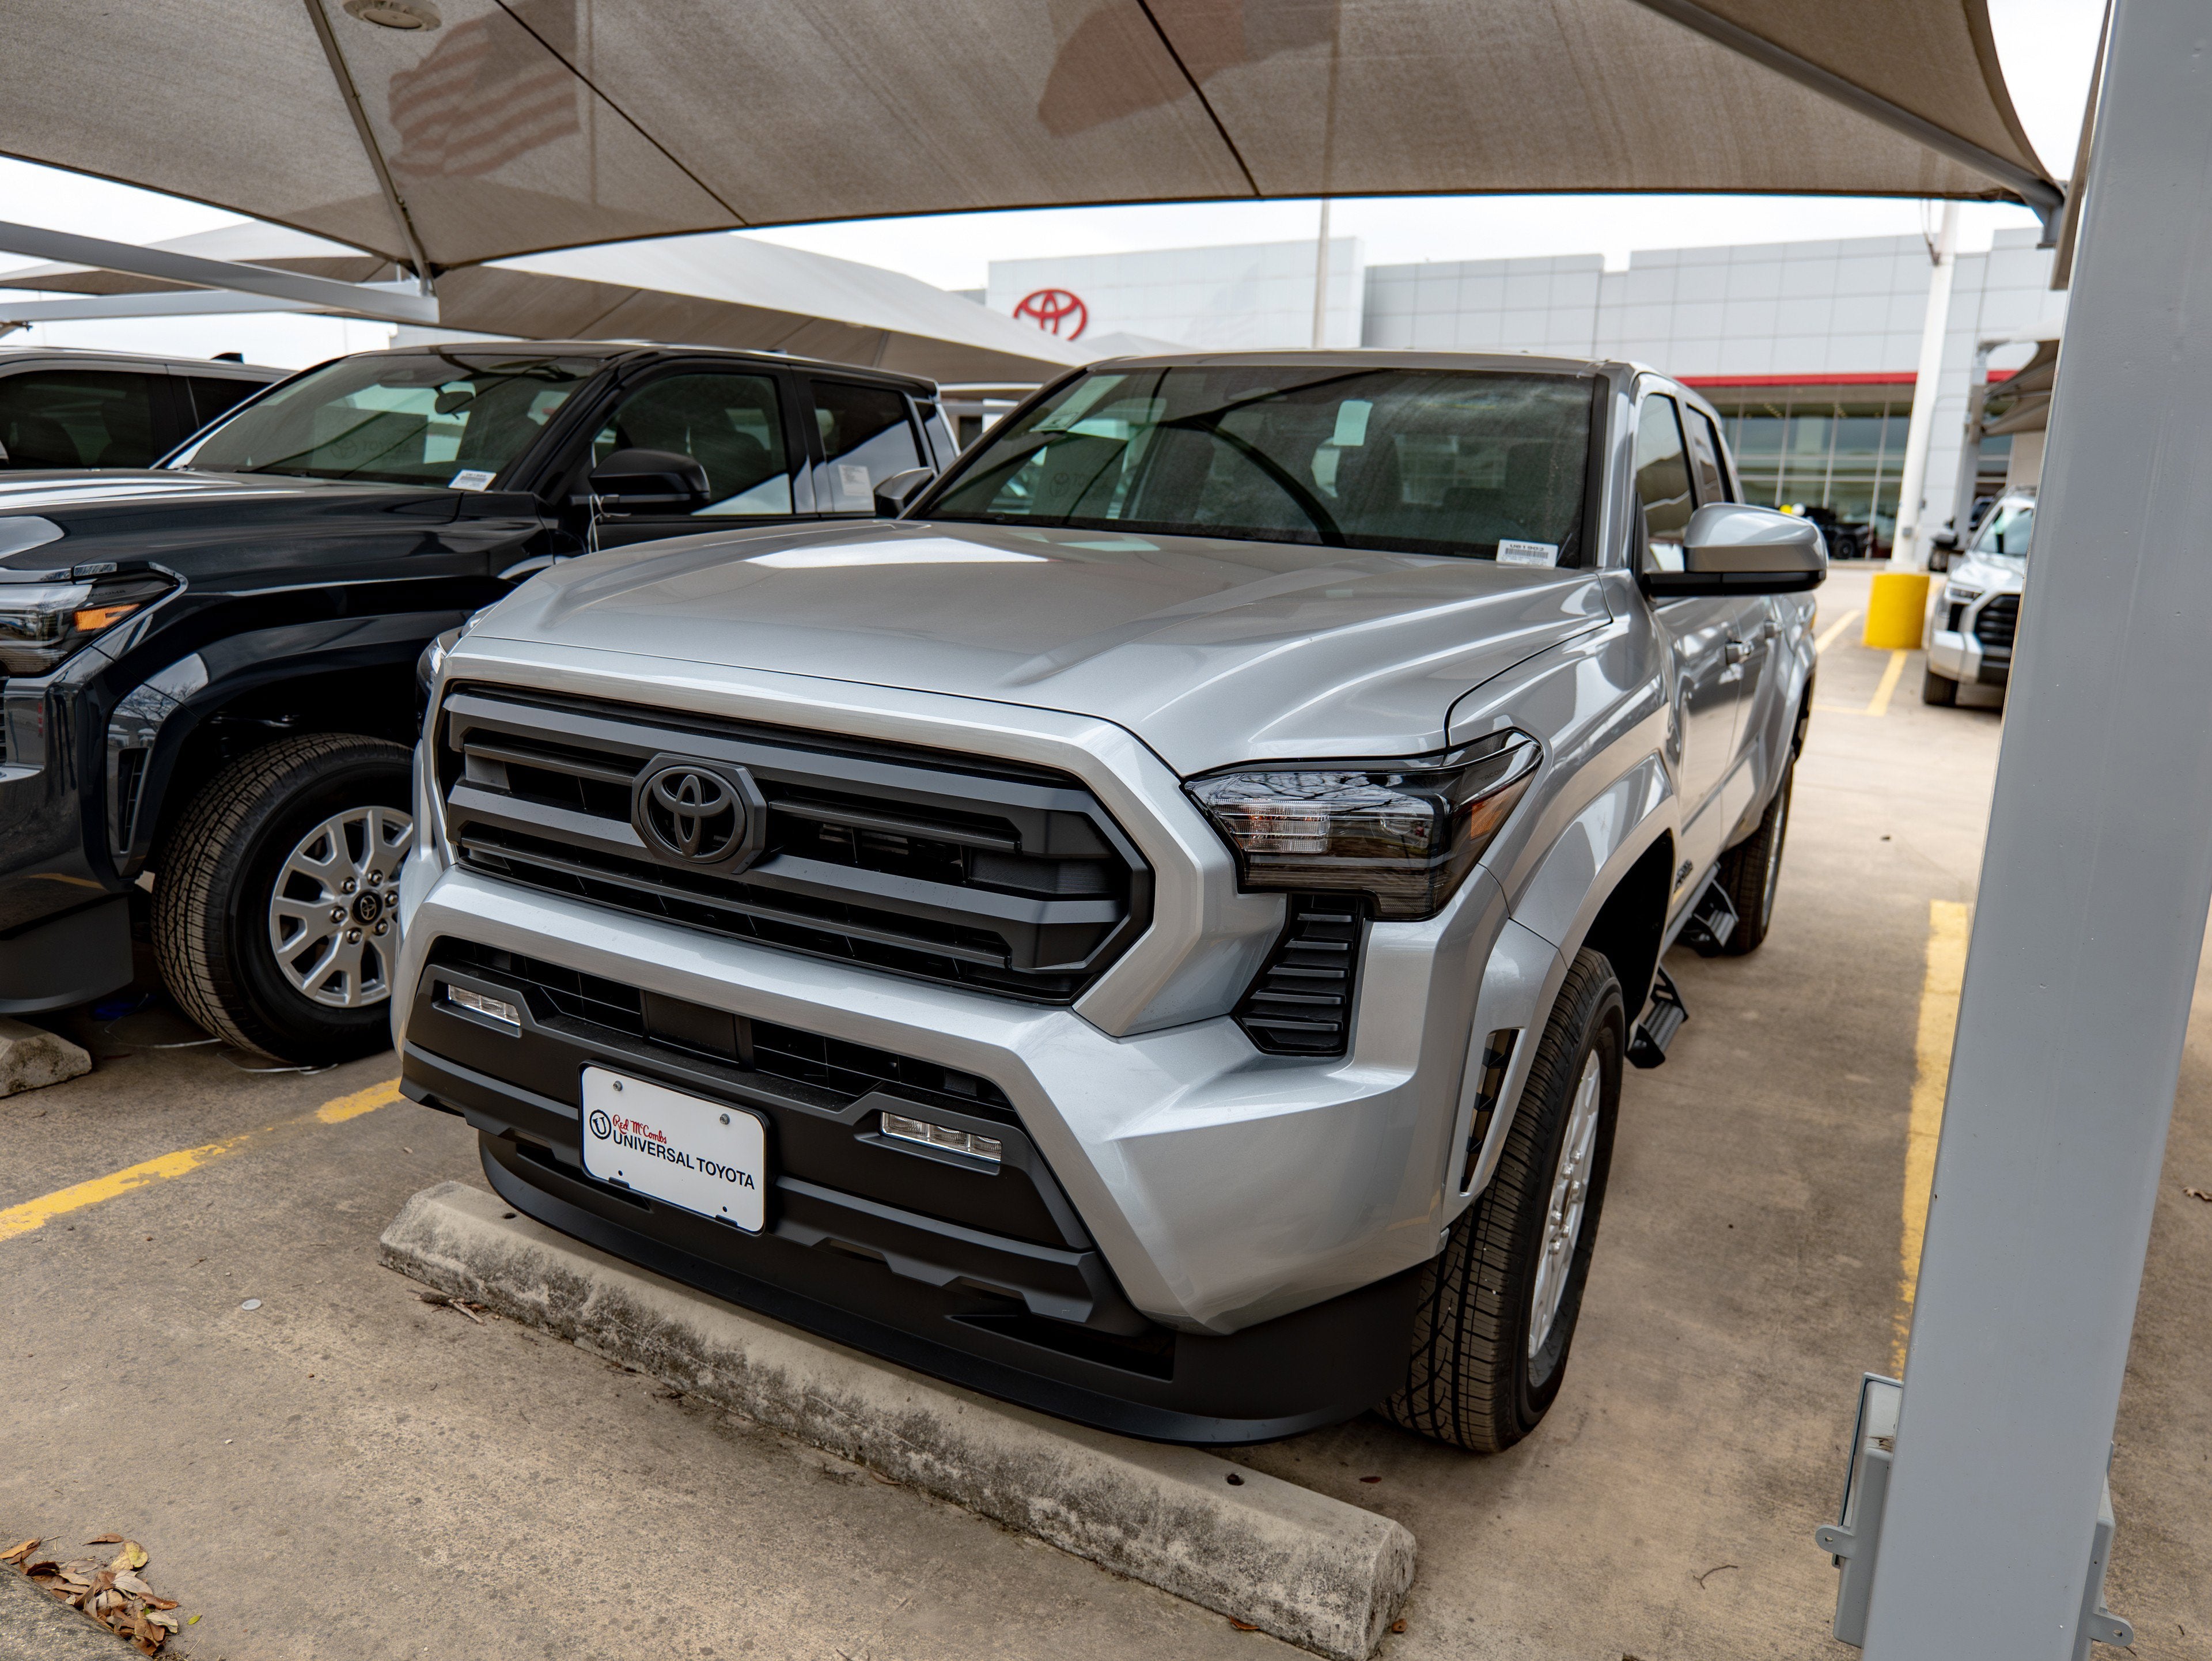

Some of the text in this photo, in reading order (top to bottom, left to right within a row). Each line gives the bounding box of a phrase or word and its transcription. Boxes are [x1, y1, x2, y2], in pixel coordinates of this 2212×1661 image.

[1478, 765, 1509, 781] TACOMA
[613, 1114, 667, 1144] Red McCombs
[613, 1129, 755, 1190] UNIVERSAL TOYOTA
